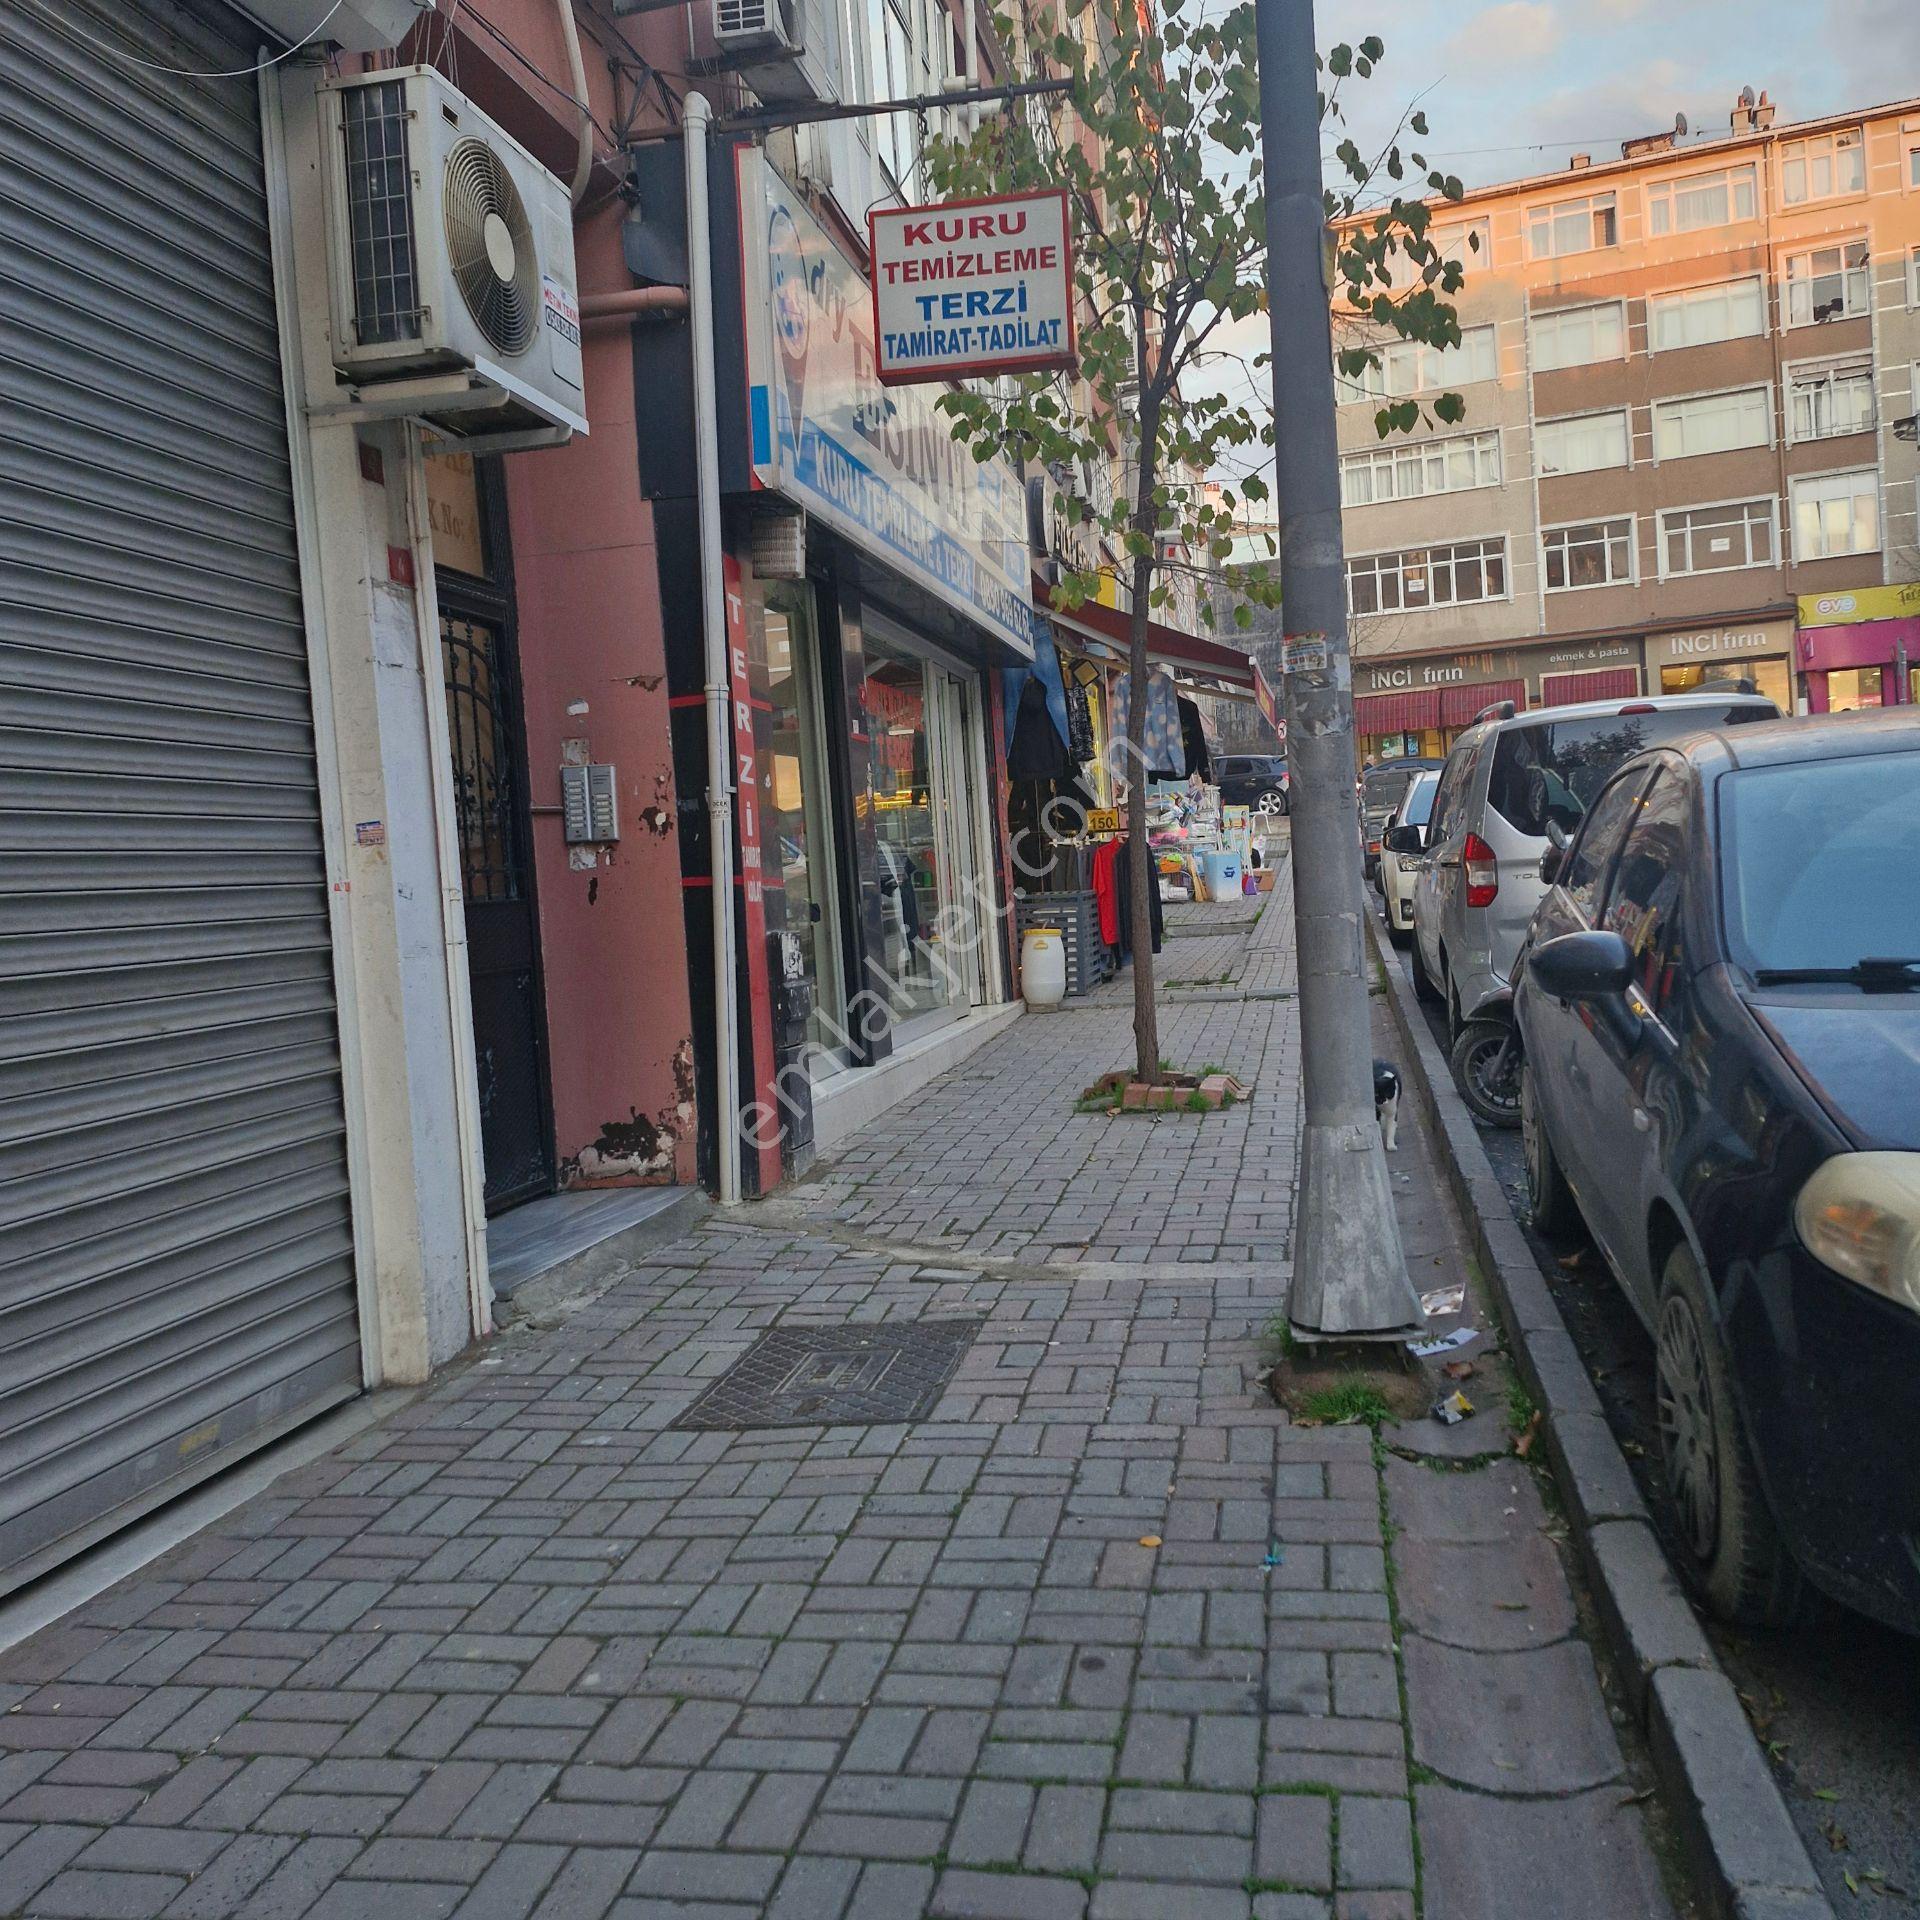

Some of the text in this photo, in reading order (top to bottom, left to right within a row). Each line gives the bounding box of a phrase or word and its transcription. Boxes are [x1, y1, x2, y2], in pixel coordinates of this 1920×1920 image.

[904, 211, 1027, 246] KURU
[882, 245, 1057, 284] TEMİZLEME
[916, 279, 1028, 321] TERZİ
[884, 316, 1062, 359] TAMİRAT-TADİLAT
[814, 434, 860, 516] KURU
[1817, 596, 1856, 614] eve
[1550, 646, 1630, 663] ekmek & pasta
[1722, 632, 1767, 649] fırın
[1371, 665, 1463, 688] İNCİ fırın
[728, 592, 755, 838] TERZİ
[1090, 816, 1113, 829] 150
